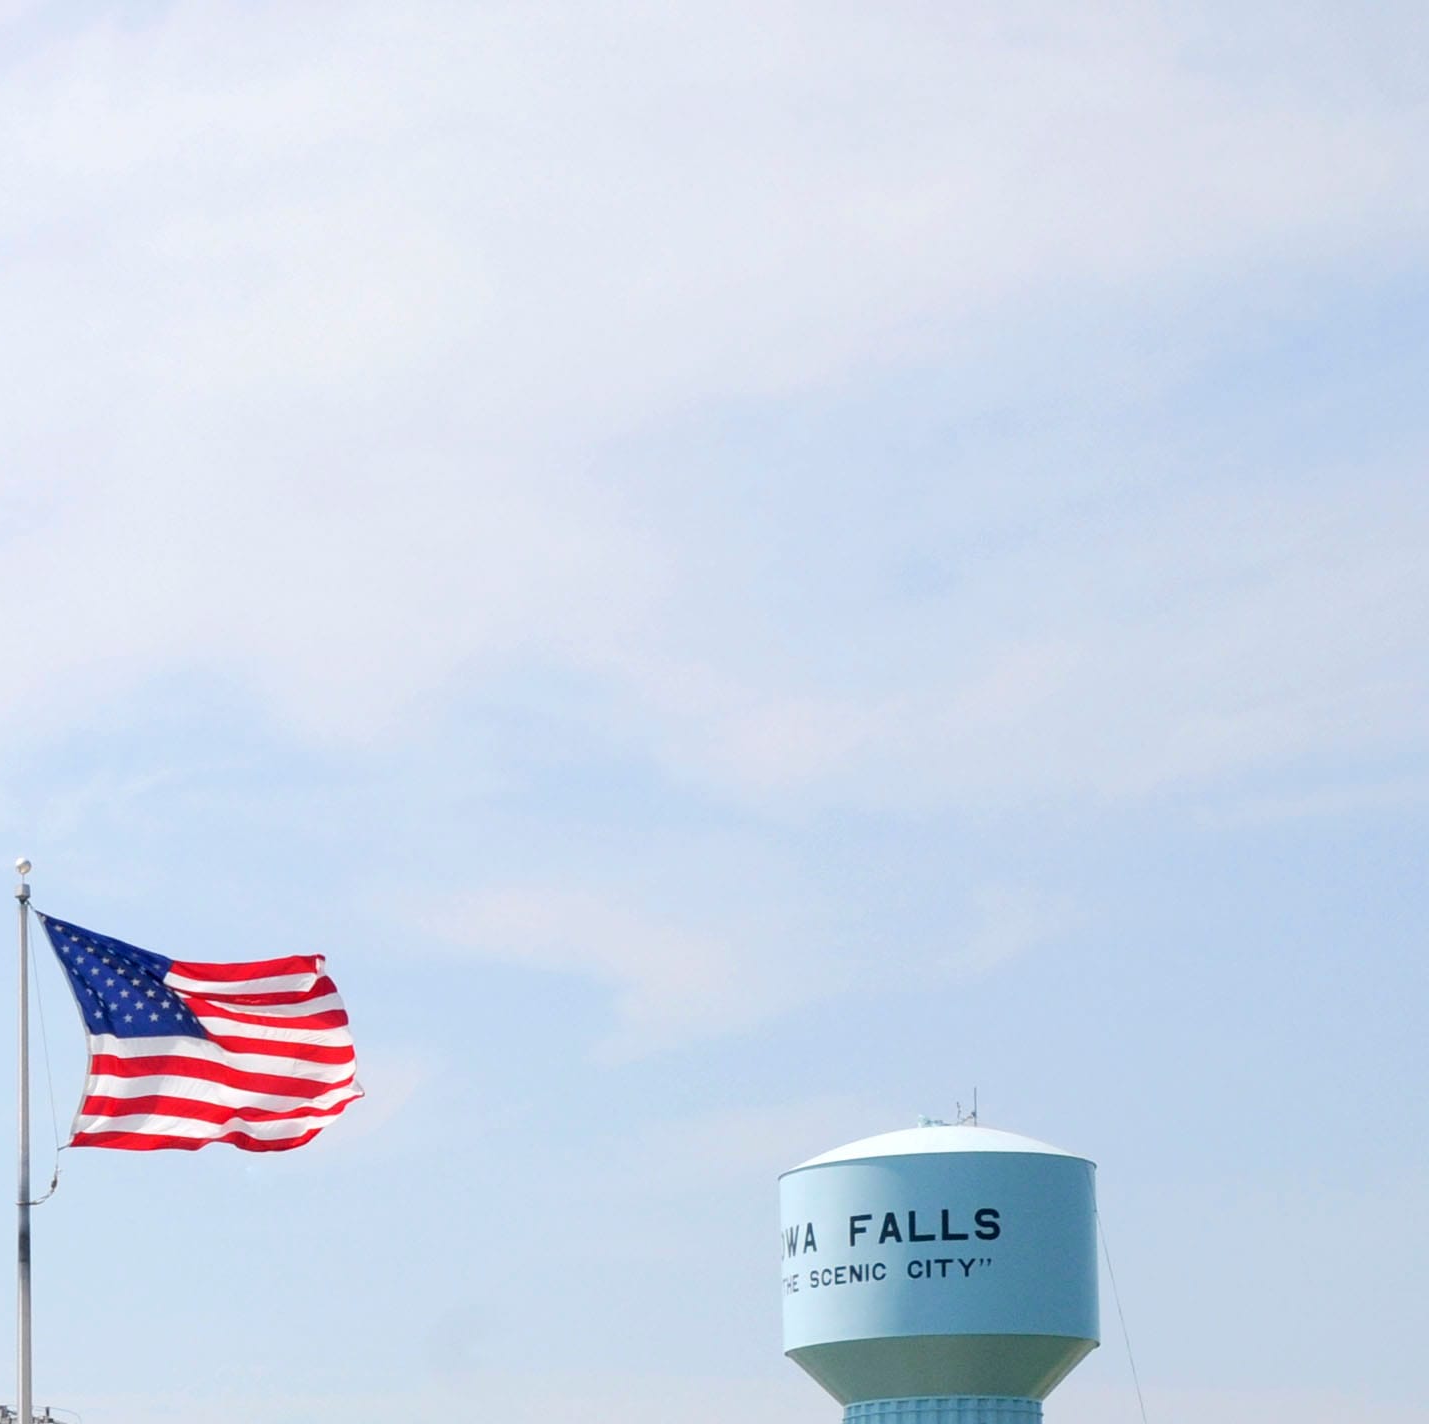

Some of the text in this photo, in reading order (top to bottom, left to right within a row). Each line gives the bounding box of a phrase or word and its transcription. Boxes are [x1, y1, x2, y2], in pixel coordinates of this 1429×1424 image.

[781, 1207, 1002, 1261] WA FALLS
[810, 1262, 887, 1289] SCENIC
